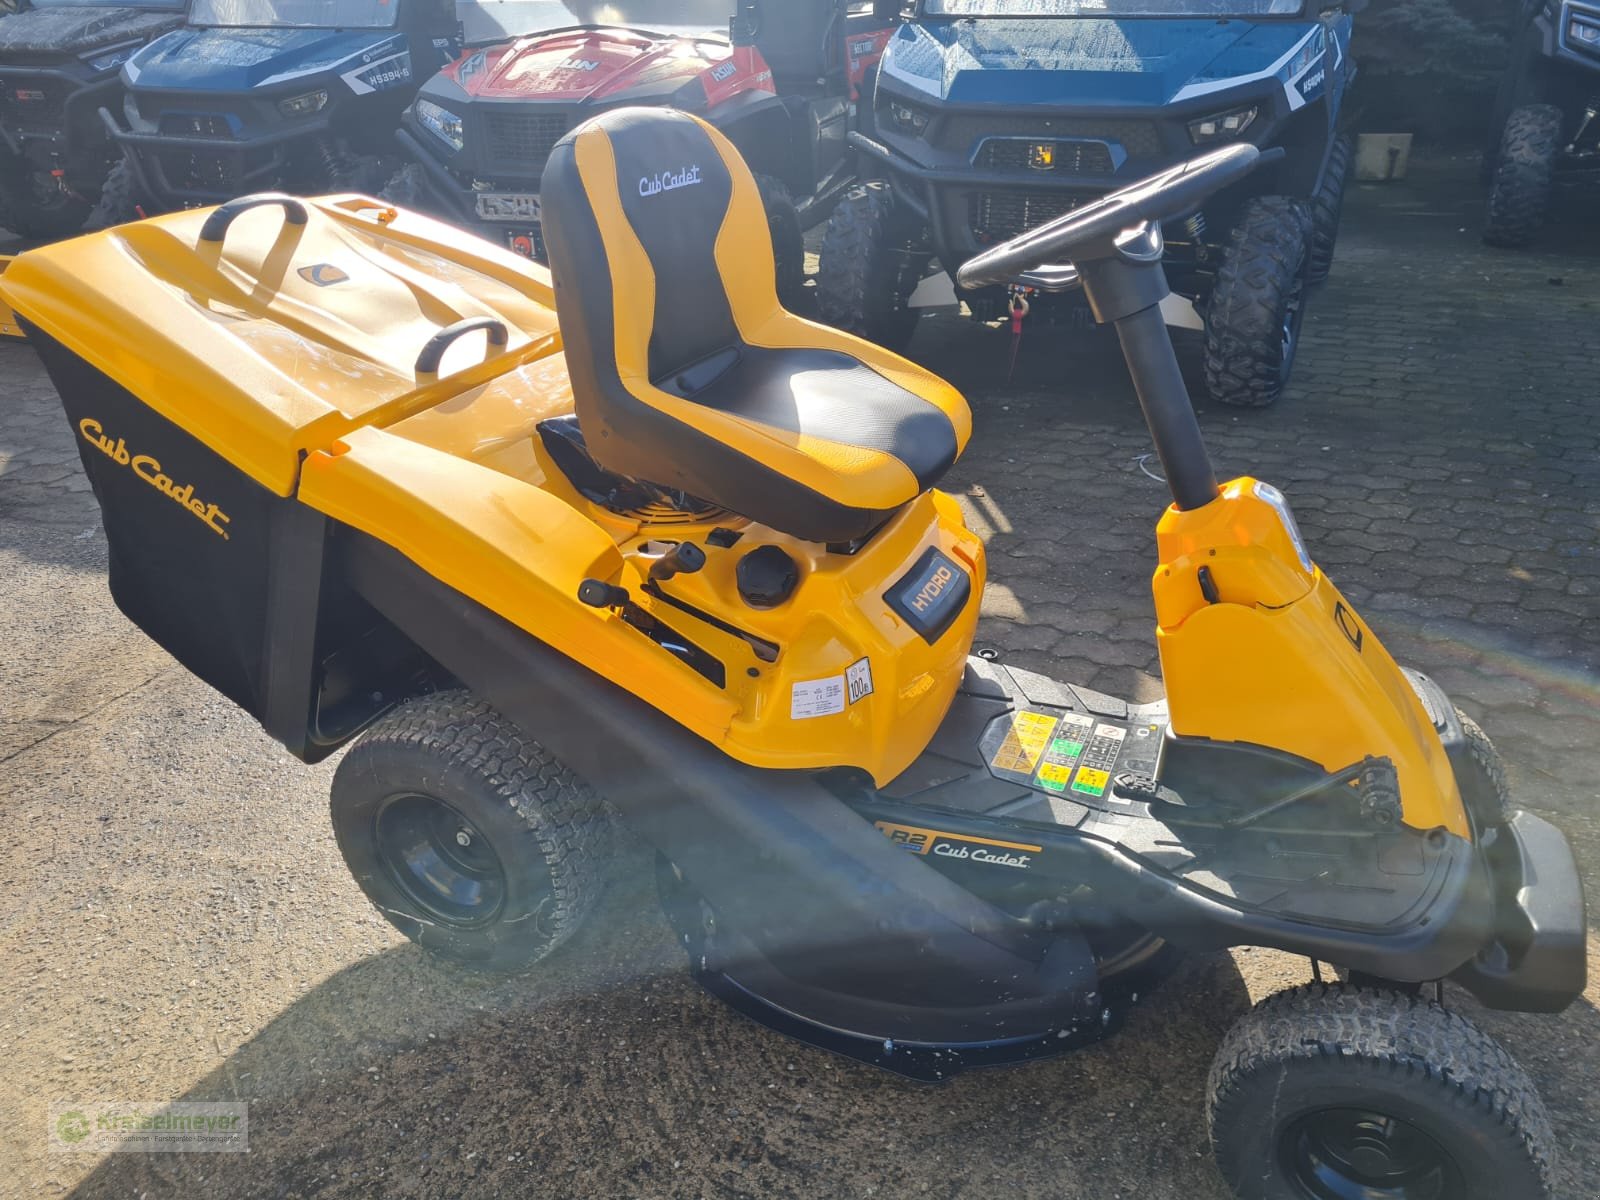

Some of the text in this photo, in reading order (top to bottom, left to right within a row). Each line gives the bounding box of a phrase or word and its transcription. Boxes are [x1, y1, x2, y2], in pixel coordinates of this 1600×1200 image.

[639, 164, 701, 197] Cub Cadet
[79, 418, 230, 536] Cub Cadet
[911, 566, 952, 612] HYDRO
[934, 843, 1031, 869] Cub Cadet
